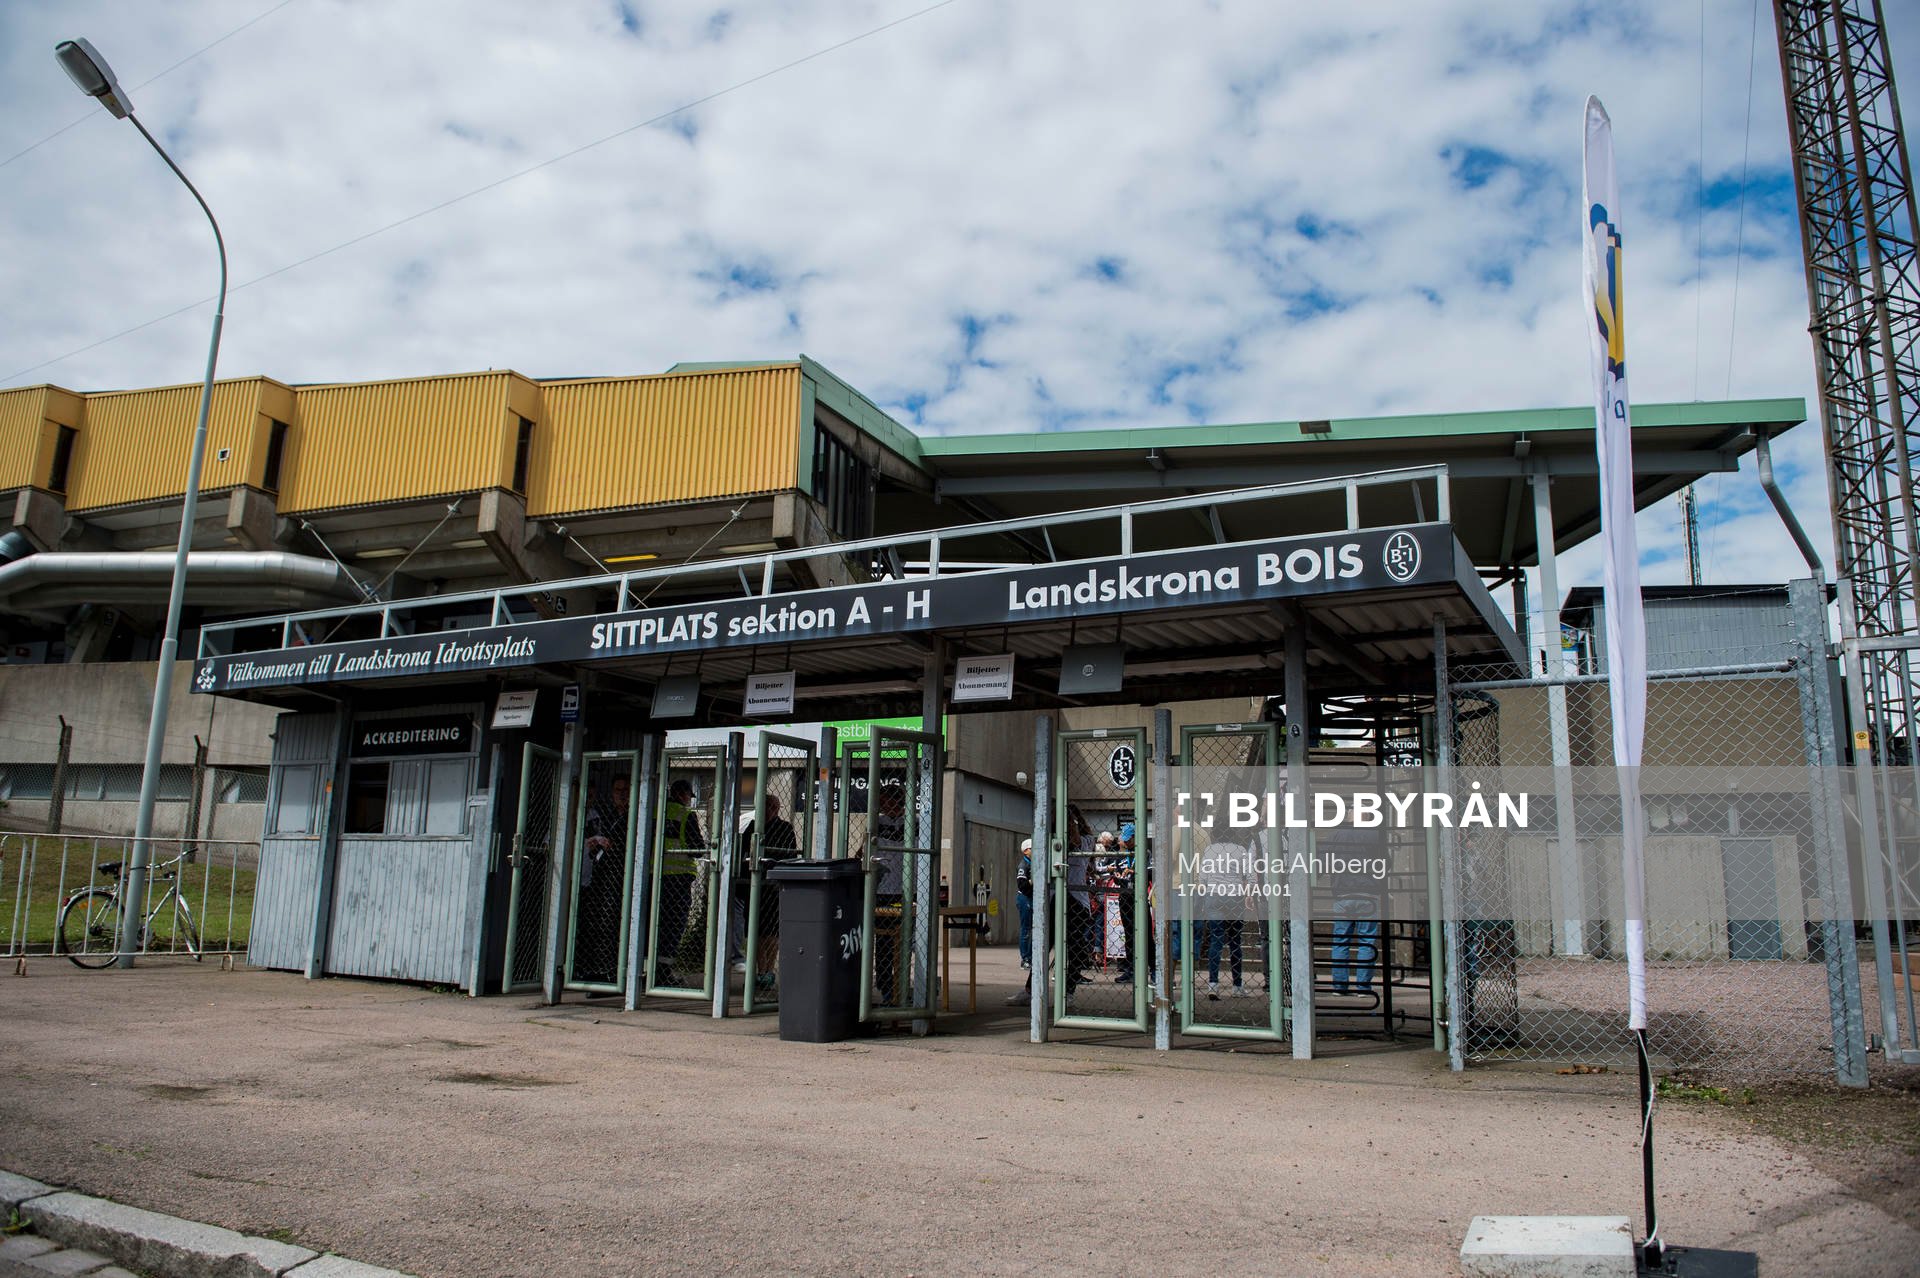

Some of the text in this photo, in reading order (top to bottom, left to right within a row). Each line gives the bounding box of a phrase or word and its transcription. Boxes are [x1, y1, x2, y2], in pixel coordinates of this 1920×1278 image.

[1009, 543, 1363, 611] Landskrona BOIS
[591, 611, 719, 649] SITTPLATS
[727, 602, 836, 637] sektion
[846, 596, 871, 625] A
[906, 589, 931, 620] H
[226, 635, 537, 683] Välkommen till Landskrona Idrottsplats
[965, 666, 1001, 674] Biljetter
[755, 682, 784, 690] Biljetter
[957, 681, 1008, 690] Abonnemang
[747, 696, 790, 704] Abonnemang
[363, 727, 460, 746] ACKREDITERING
